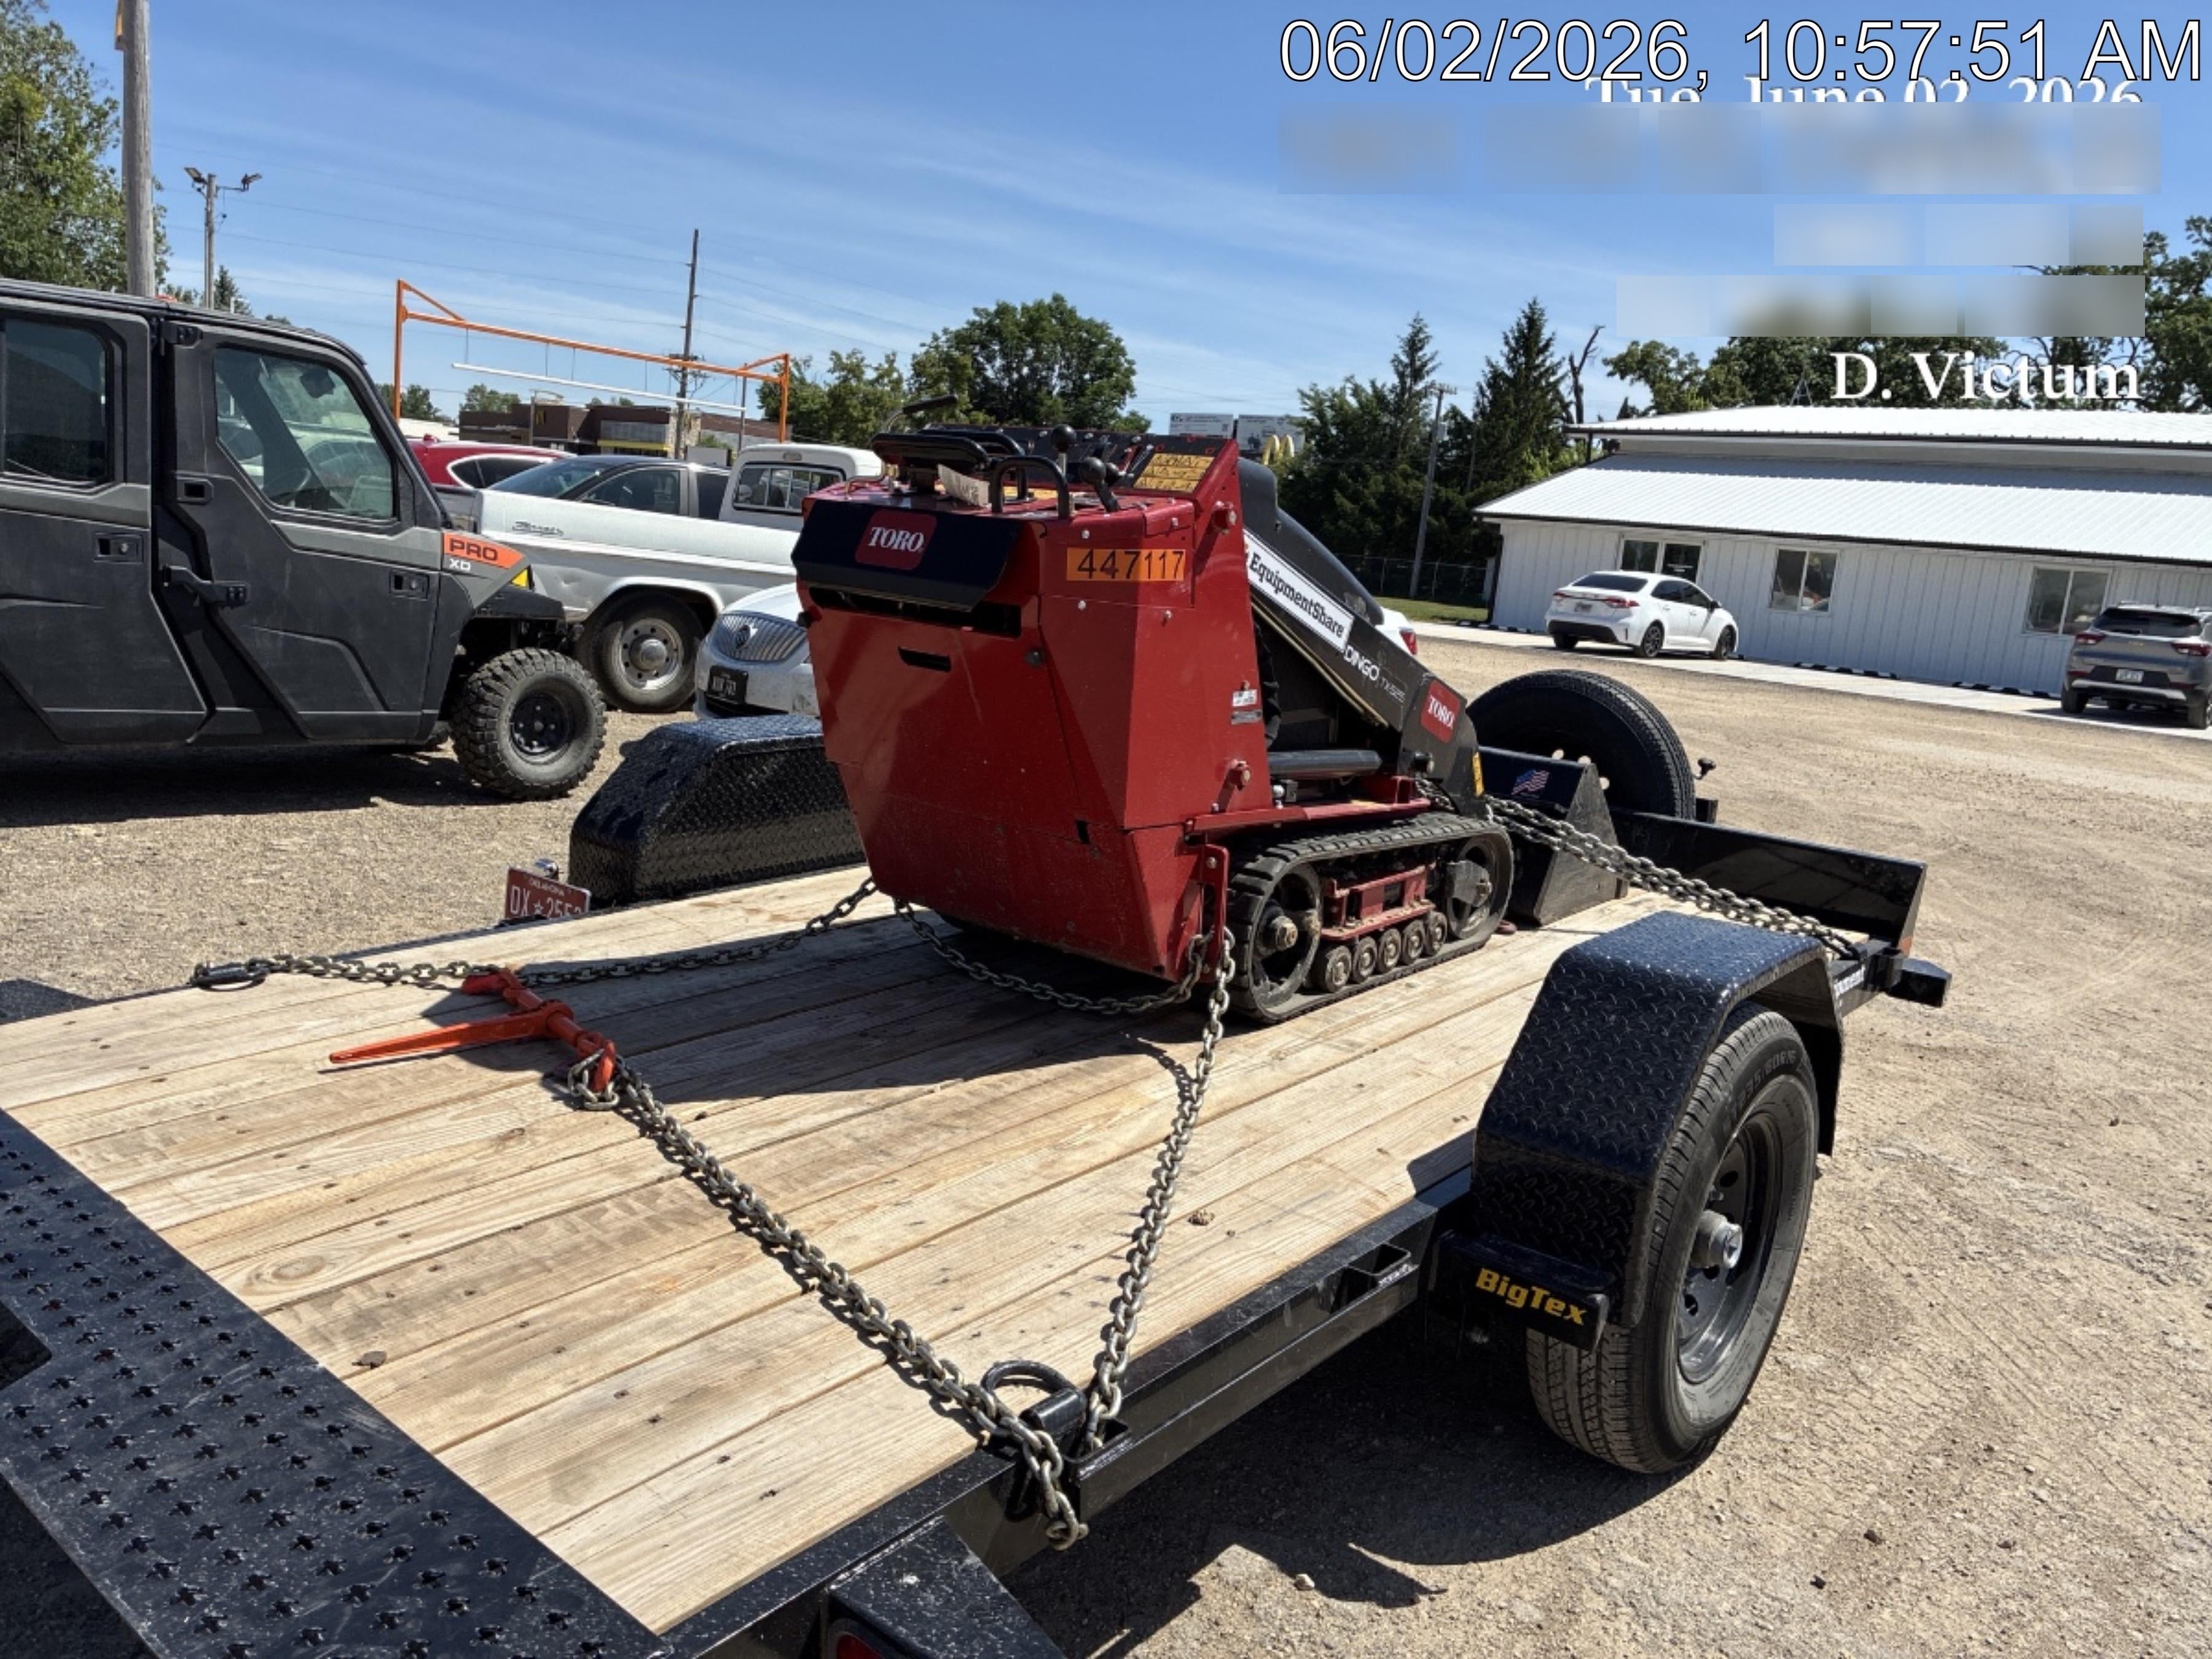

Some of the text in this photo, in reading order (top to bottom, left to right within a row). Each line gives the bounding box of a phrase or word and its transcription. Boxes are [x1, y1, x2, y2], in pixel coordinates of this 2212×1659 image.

[449, 538, 498, 561] PRO
[868, 527, 925, 552] TORO
[449, 558, 471, 571] XD
[1078, 549, 1184, 579] 447117
[1250, 551, 1345, 638] EquipmentShare
[1343, 645, 1380, 681] DINGO
[1427, 695, 1456, 731] TORO
[1476, 1268, 1588, 1326] BigTex
